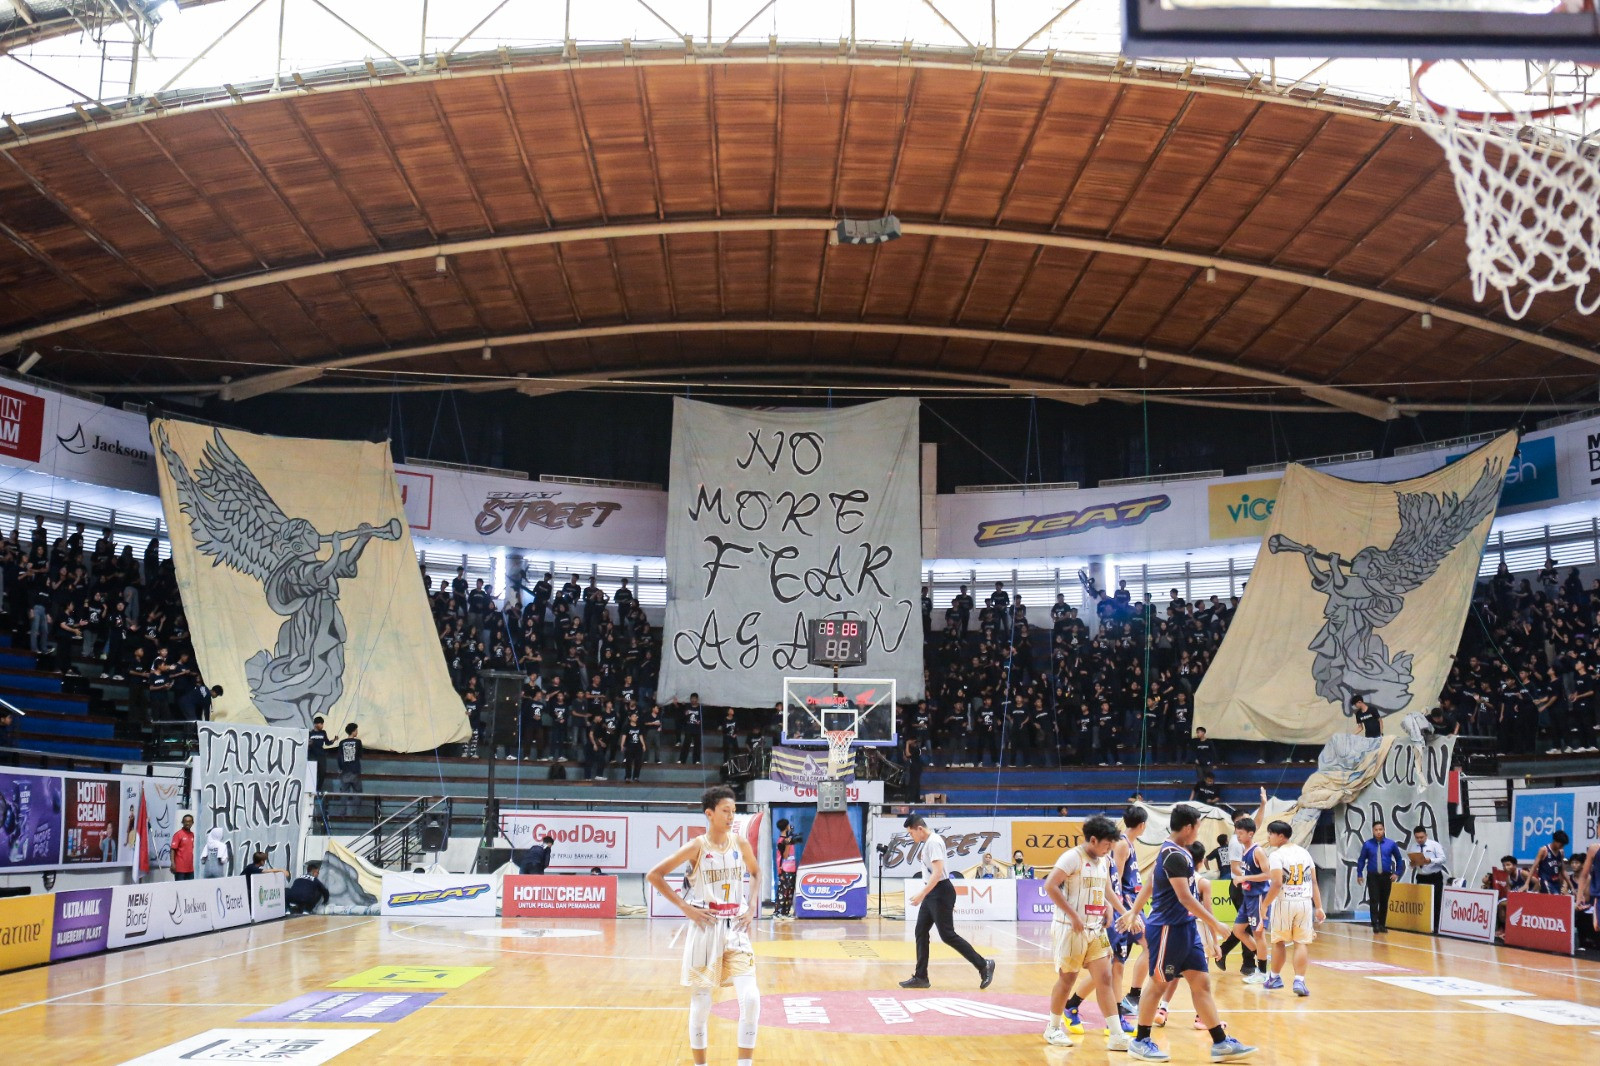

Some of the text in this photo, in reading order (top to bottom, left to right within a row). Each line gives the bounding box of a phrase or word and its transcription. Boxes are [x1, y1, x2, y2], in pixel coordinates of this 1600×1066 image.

[92, 435, 147, 459] Jackson
[737, 429, 824, 475] NO
[475, 499, 622, 535] STREET
[688, 484, 869, 536] MORE
[703, 536, 892, 602] FEAR
[674, 599, 912, 670] AGAN
[199, 727, 305, 776] TAKUT
[77, 782, 95, 802] HOT
[77, 804, 106, 821] CREAM
[205, 777, 302, 835] HANYA
[1521, 802, 1564, 851] posh
[513, 886, 541, 901] HOT
[556, 886, 606, 902] CREAM
[721, 883, 731, 902] 7
[815, 886, 831, 894] DBL
[183, 898, 207, 914] Jackson
[226, 894, 243, 910] Biznet
[126, 908, 147, 927] Bioré
[1521, 914, 1566, 933] HONDA
